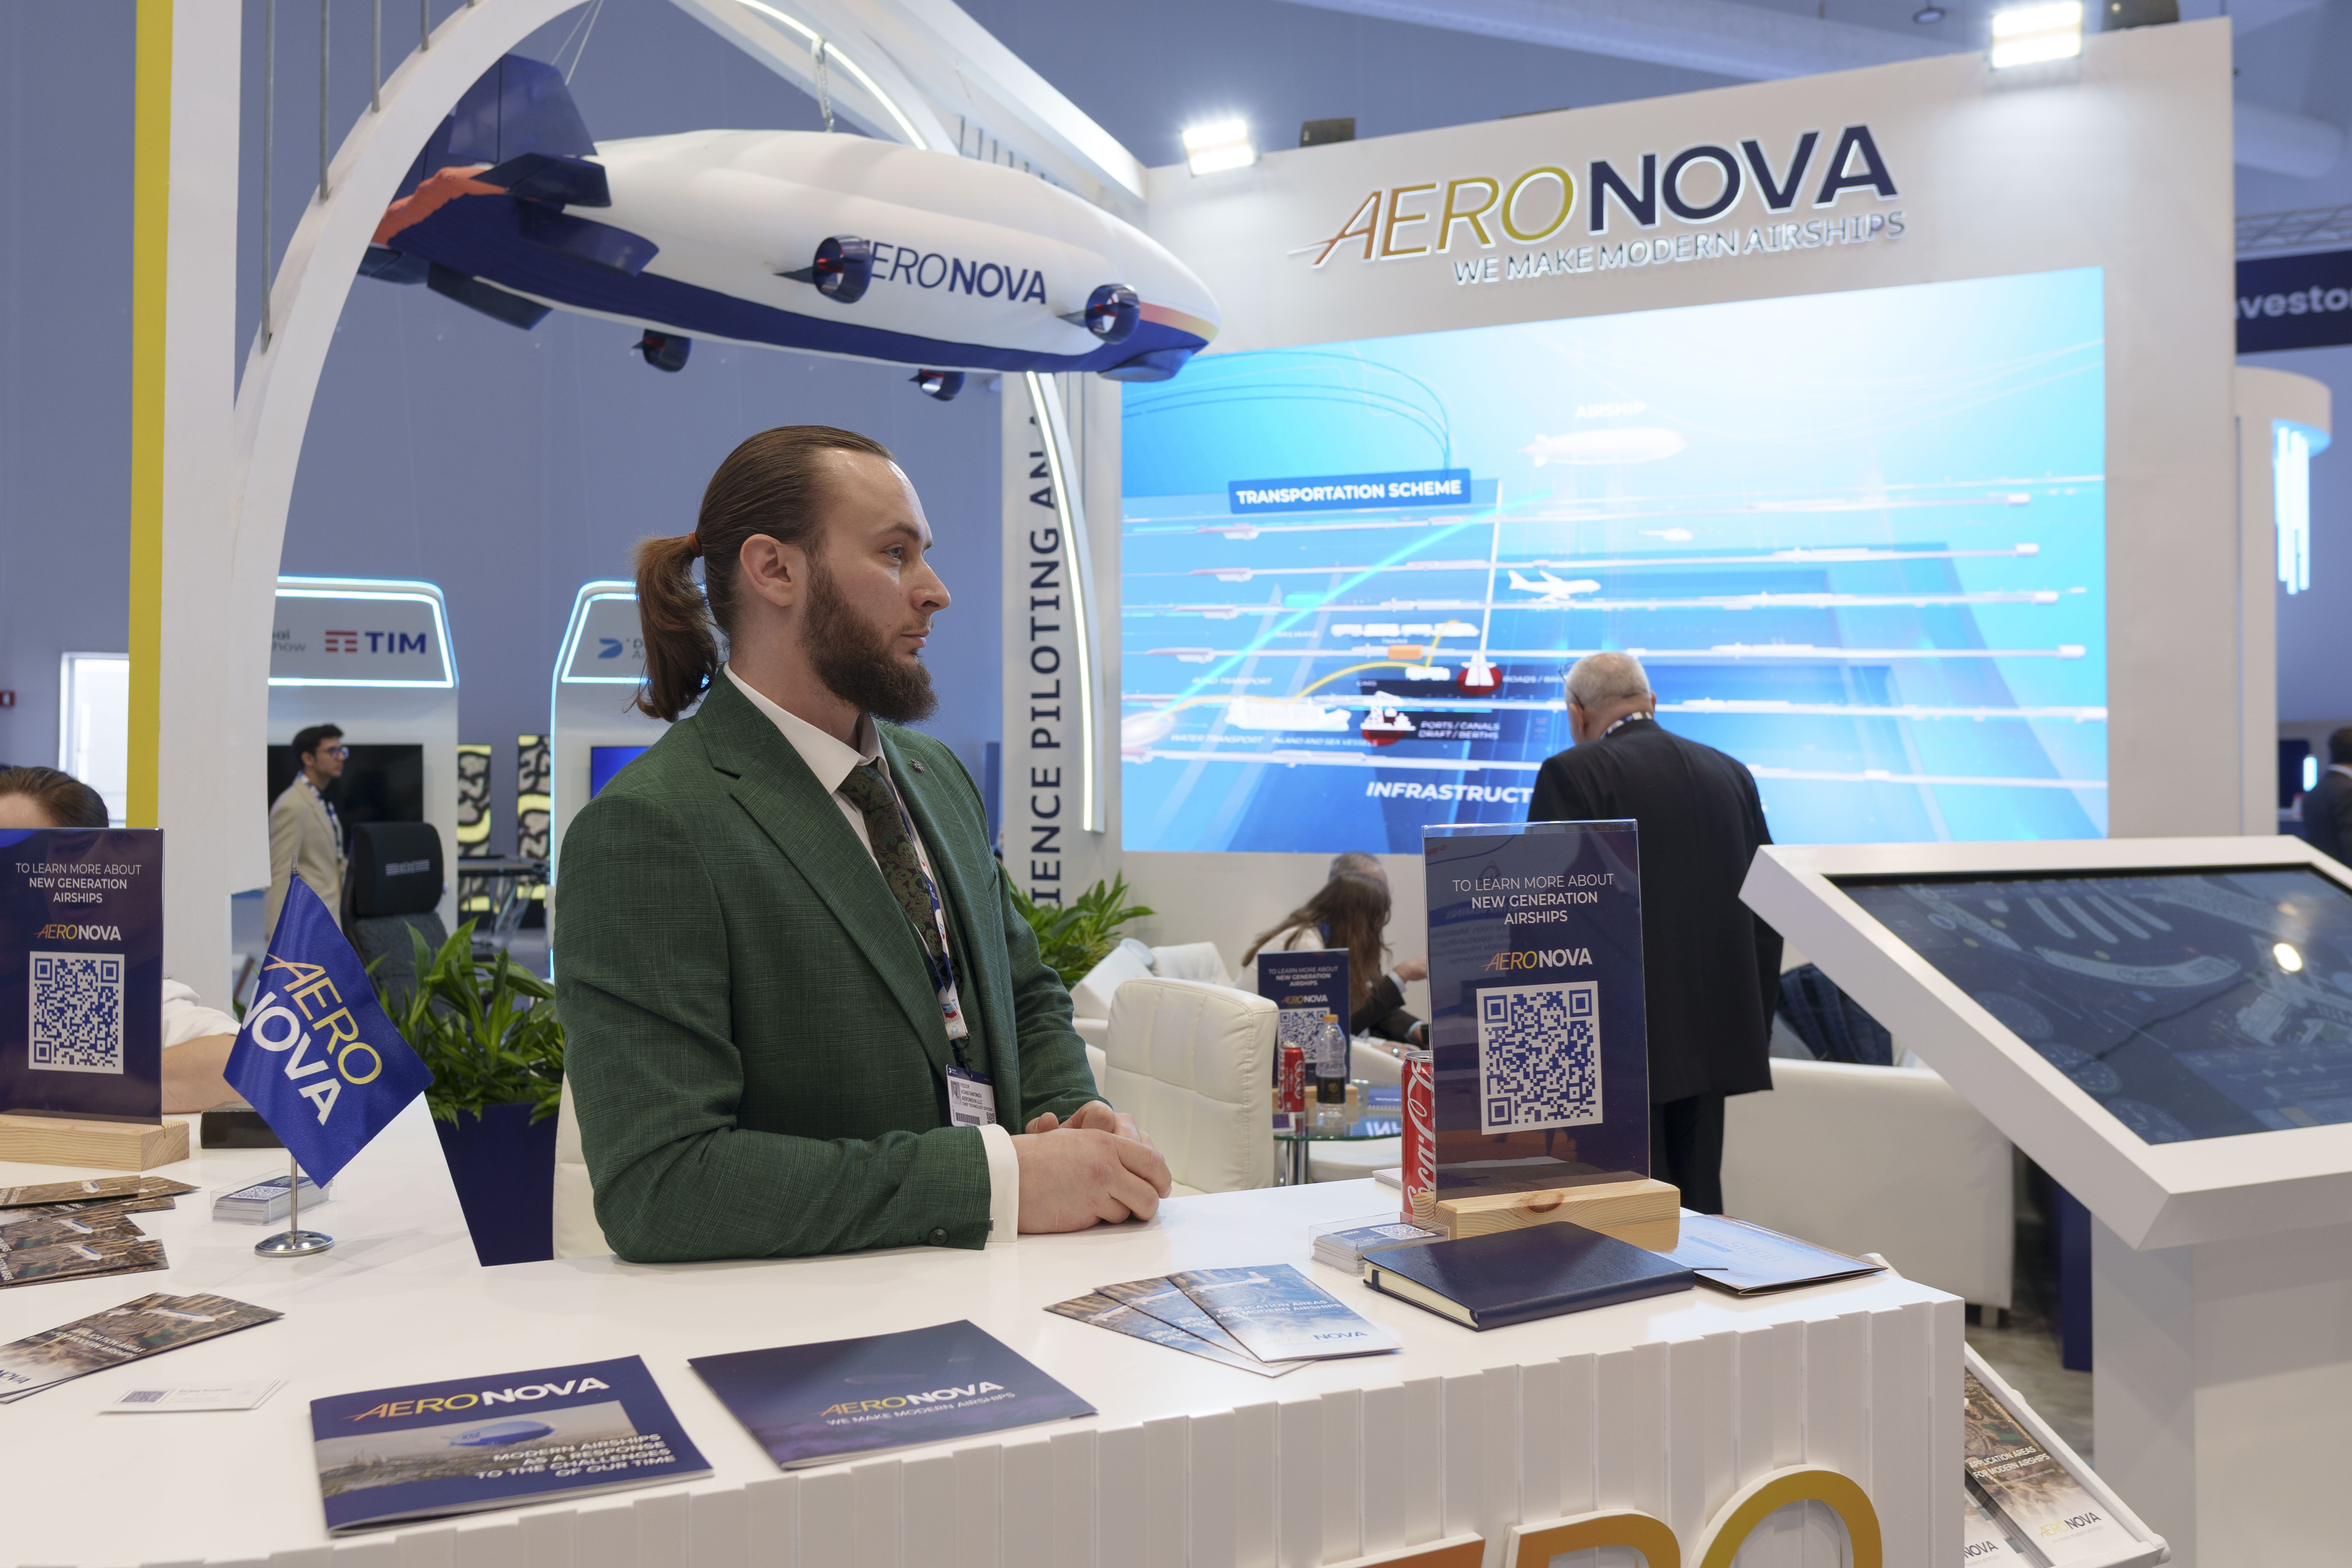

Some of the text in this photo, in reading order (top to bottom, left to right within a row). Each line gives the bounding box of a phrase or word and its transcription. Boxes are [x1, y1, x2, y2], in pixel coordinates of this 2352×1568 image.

[1287, 124, 1898, 269] AERONOVA
[1452, 211, 1906, 286] WE MAKE MODERN AIRSHIPS
[866, 239, 1046, 304] ERONOVA
[2235, 285, 2352, 319] vesto
[1575, 402, 1646, 419] AIRSHIP
[1236, 480, 1462, 505] TRANSPORTATION SCHEME
[365, 631, 426, 654] TIM
[1030, 528, 1061, 748] PILOTING
[1421, 721, 1453, 729] PORTS
[1460, 722, 1500, 731] CANALS
[1207, 735, 1264, 744] TRANSPORT
[1366, 781, 1534, 804] INFRASTRUCT
[1031, 767, 1061, 903] IENCE
[16, 863, 142, 875] TO LEARN MORE ABOUT
[30, 877, 127, 889] NEW GENERATION
[1452, 874, 1614, 892] TO LEARN MORE ABOUT
[53, 892, 102, 903] AIRSHIPS
[1472, 892, 1597, 909] NEW GENERATION
[1504, 910, 1567, 925] AIRSHIPS
[34, 924, 121, 941] AERONOVA
[1480, 948, 1593, 971] AERONOVA
[1281, 994, 1328, 1004] AERONOVA
[263, 953, 382, 1084] AERO
[1218, 1302, 1290, 1313] APPLICATION
[1242, 1307, 1290, 1315] MODERN
[1293, 1303, 1342, 1311] AIRSHIPS
[339, 1377, 610, 1421] AERONOVA
[809, 1381, 1004, 1417] AERONOVA
[826, 1392, 1015, 1425] WE MAKE MODERN AIRSHIPS
[493, 1434, 661, 1462] MODERN AIRSHIPS
[523, 1441, 666, 1466] AS A RESPONSE
[1969, 1446, 2036, 1468] APPLICATION AREAS
[474, 1448, 671, 1479] TO THE CHALLENGES
[555, 1455, 676, 1477] OF OUR TIME
[1973, 1453, 2050, 1478] FOR MODERN AIRSHIPS
[2038, 1512, 2102, 1538] AERONOVA
